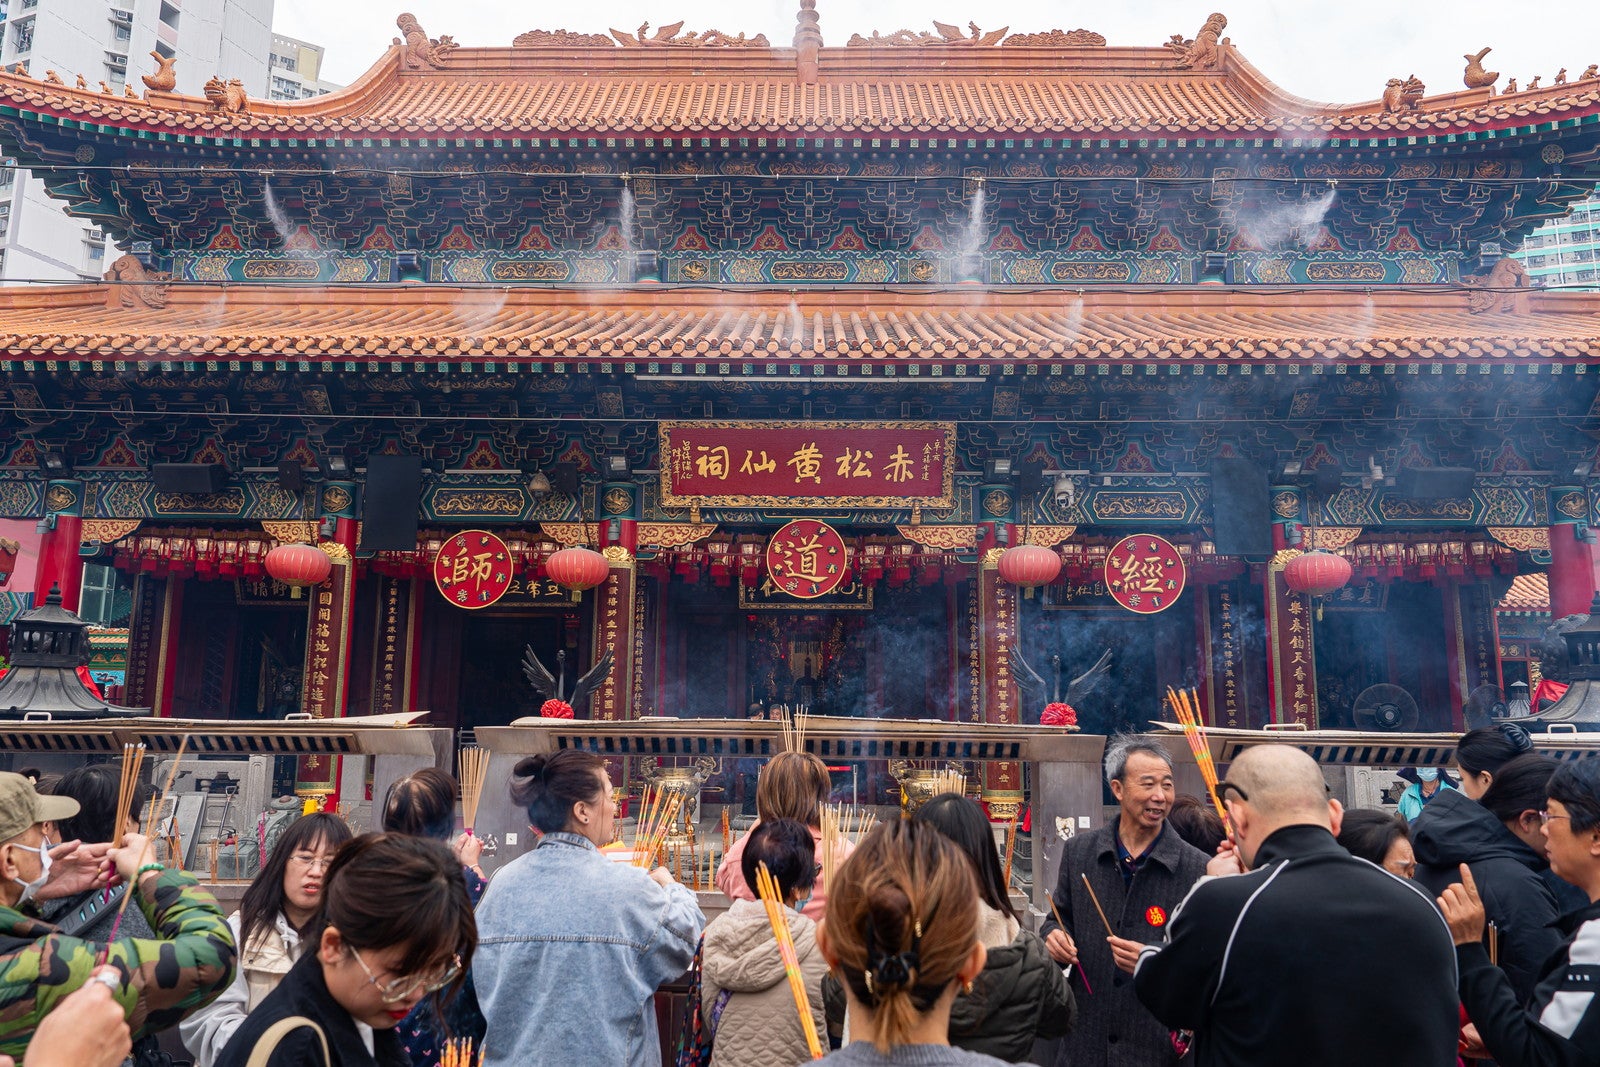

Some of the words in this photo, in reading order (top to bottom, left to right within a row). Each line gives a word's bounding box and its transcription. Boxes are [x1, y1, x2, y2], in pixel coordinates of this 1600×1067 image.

[452, 546, 493, 592] 師
[784, 534, 829, 584] 道
[1120, 553, 1165, 594] 經
